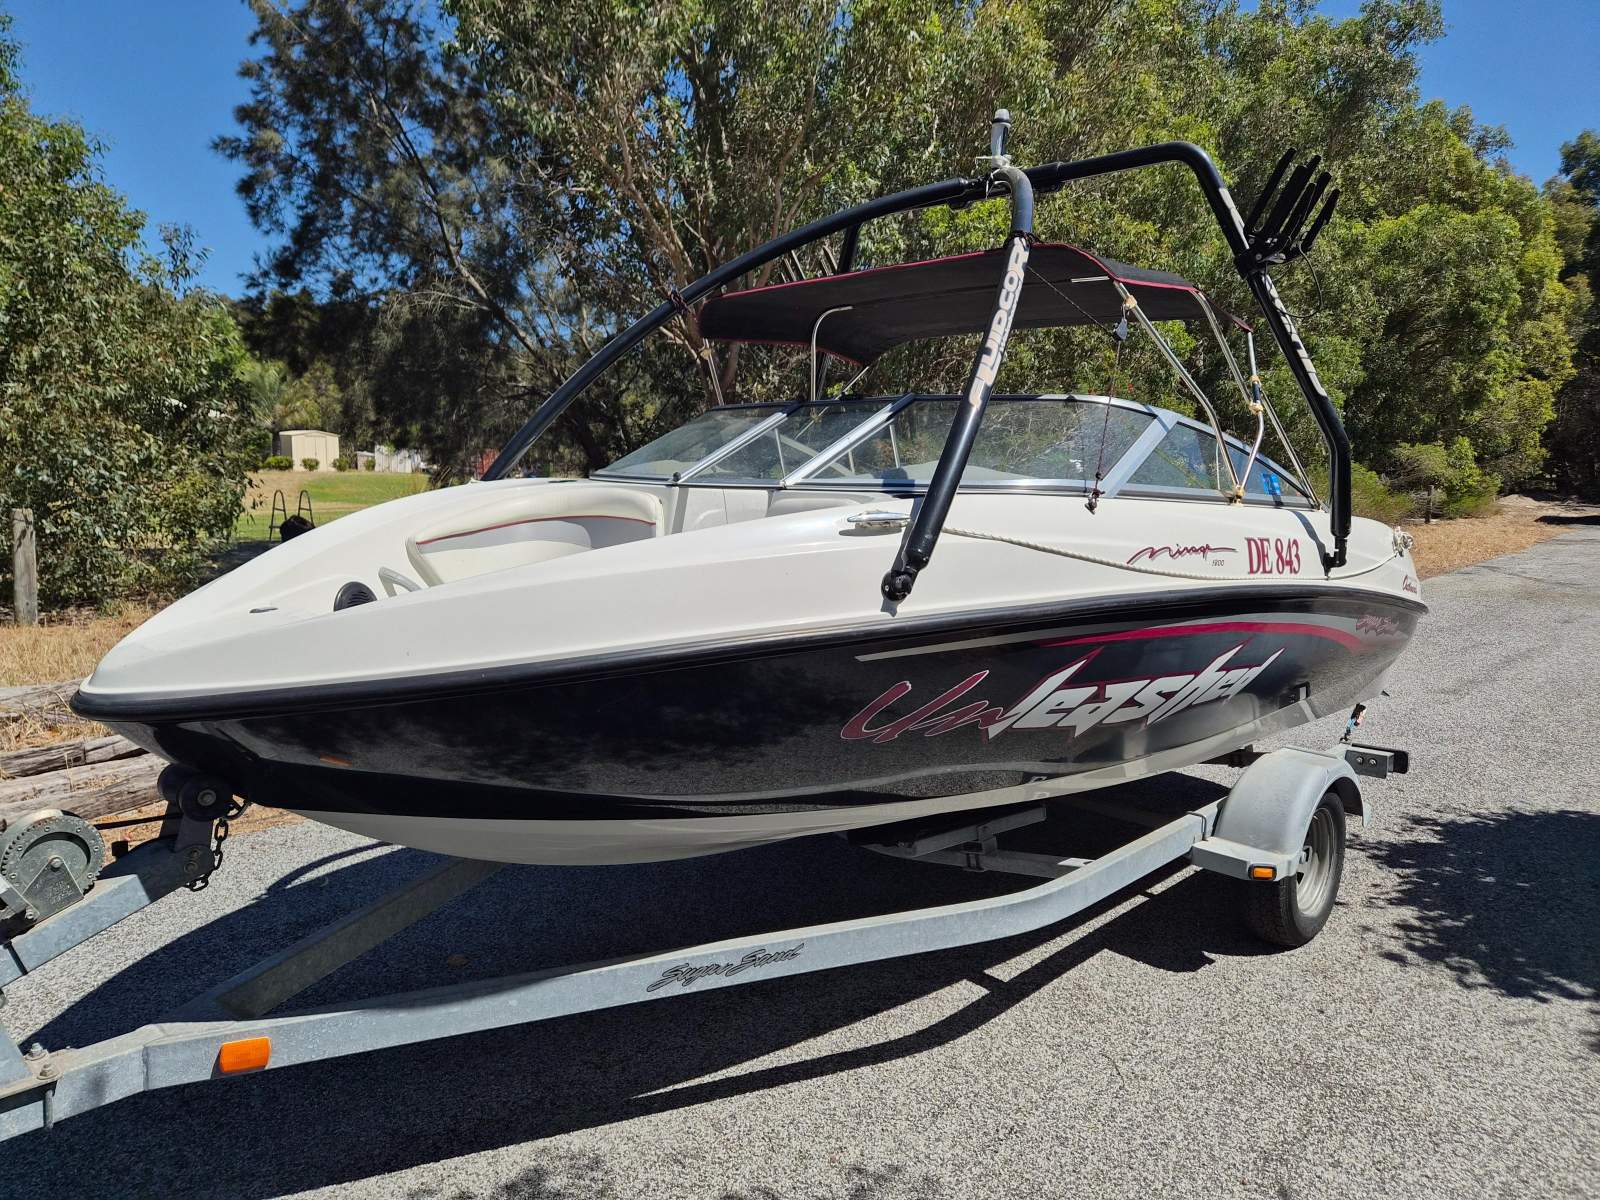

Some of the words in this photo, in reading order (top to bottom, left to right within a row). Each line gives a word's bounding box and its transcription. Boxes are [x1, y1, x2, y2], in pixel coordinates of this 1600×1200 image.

[1244, 536, 1273, 574] DE
[1275, 537, 1301, 574] 843
[646, 962, 734, 993] Sugar
[725, 943, 805, 977] Sand
